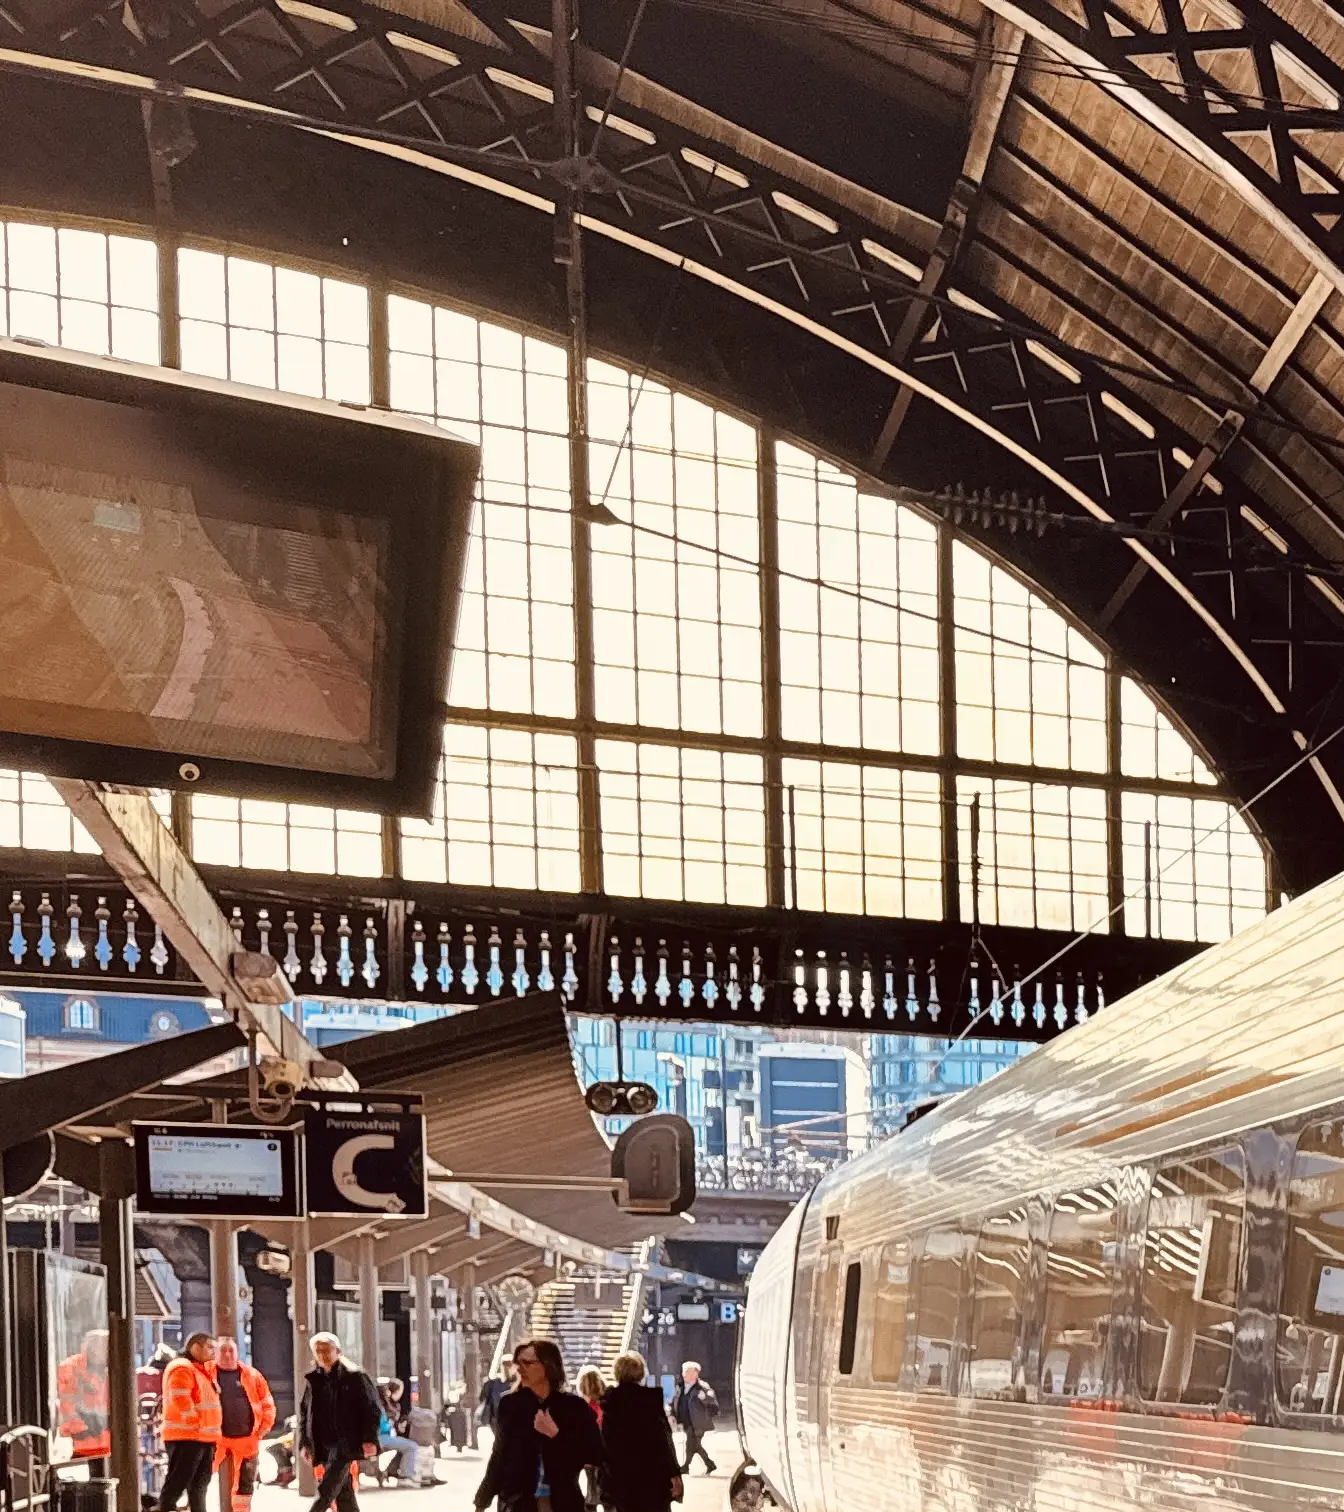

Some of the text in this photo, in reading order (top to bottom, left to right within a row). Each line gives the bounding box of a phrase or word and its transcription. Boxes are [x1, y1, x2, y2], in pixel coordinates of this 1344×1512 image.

[326, 1117, 400, 1132] Perronafsnit
[332, 1134, 404, 1209] C
[720, 1302, 737, 1324] B
